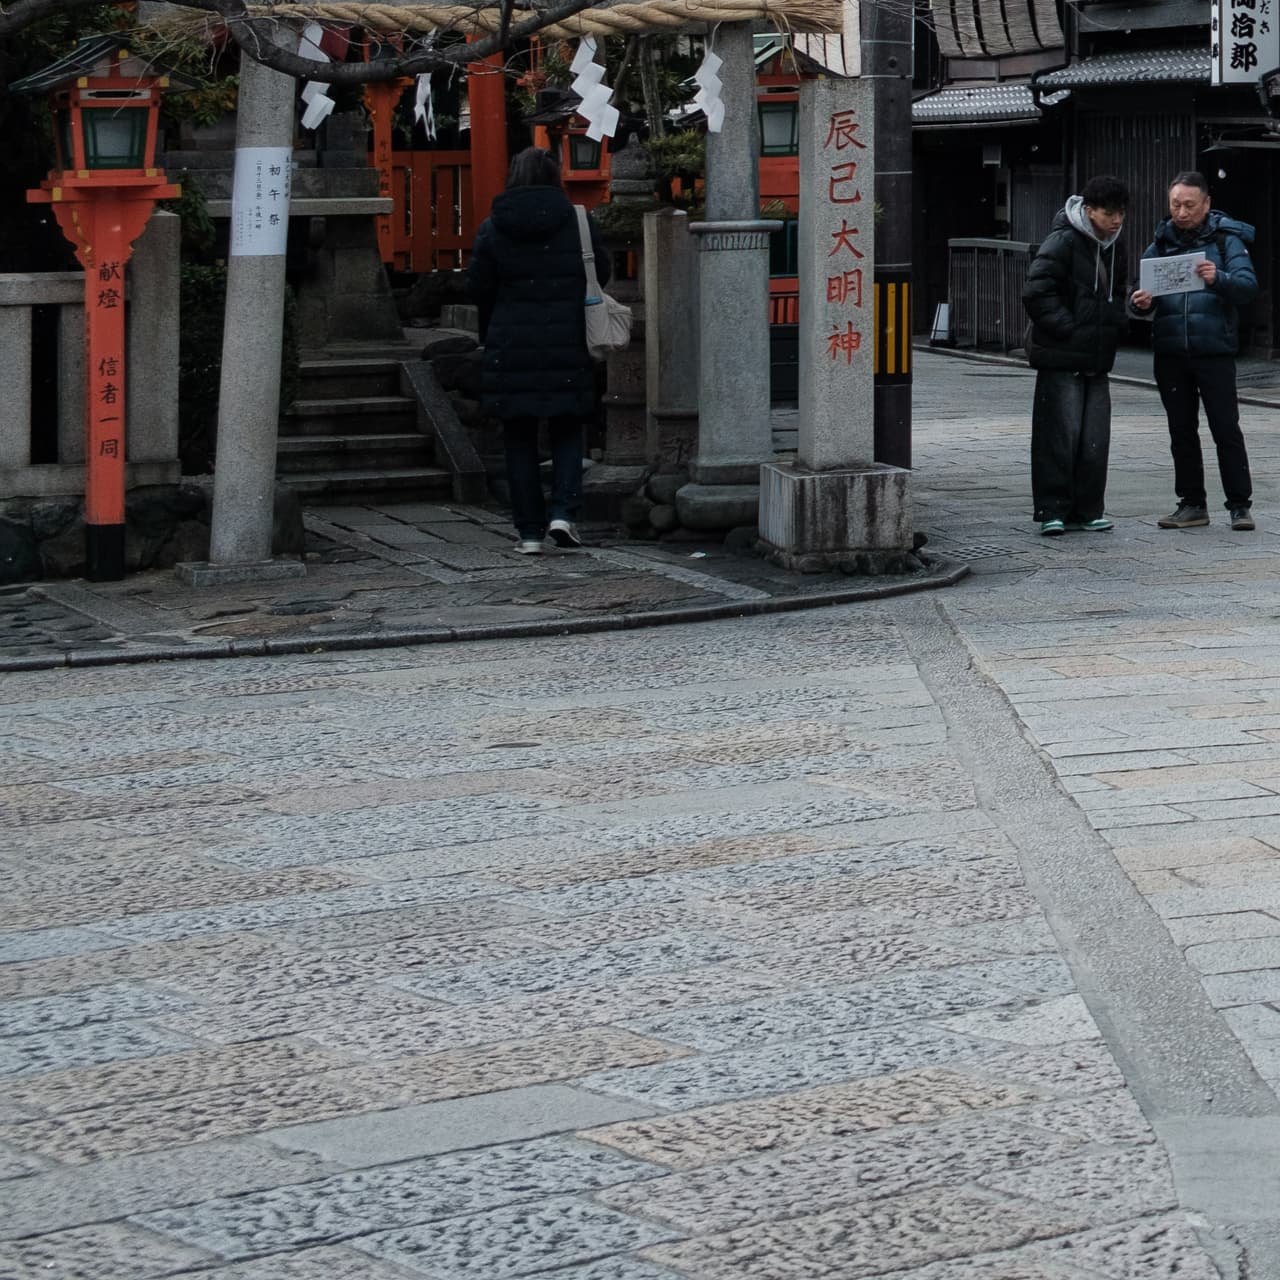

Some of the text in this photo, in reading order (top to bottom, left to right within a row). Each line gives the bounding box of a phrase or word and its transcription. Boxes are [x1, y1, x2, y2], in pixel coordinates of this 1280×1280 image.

[269, 164, 281, 226] 初午祭
[98, 357, 119, 459] 信者一同
